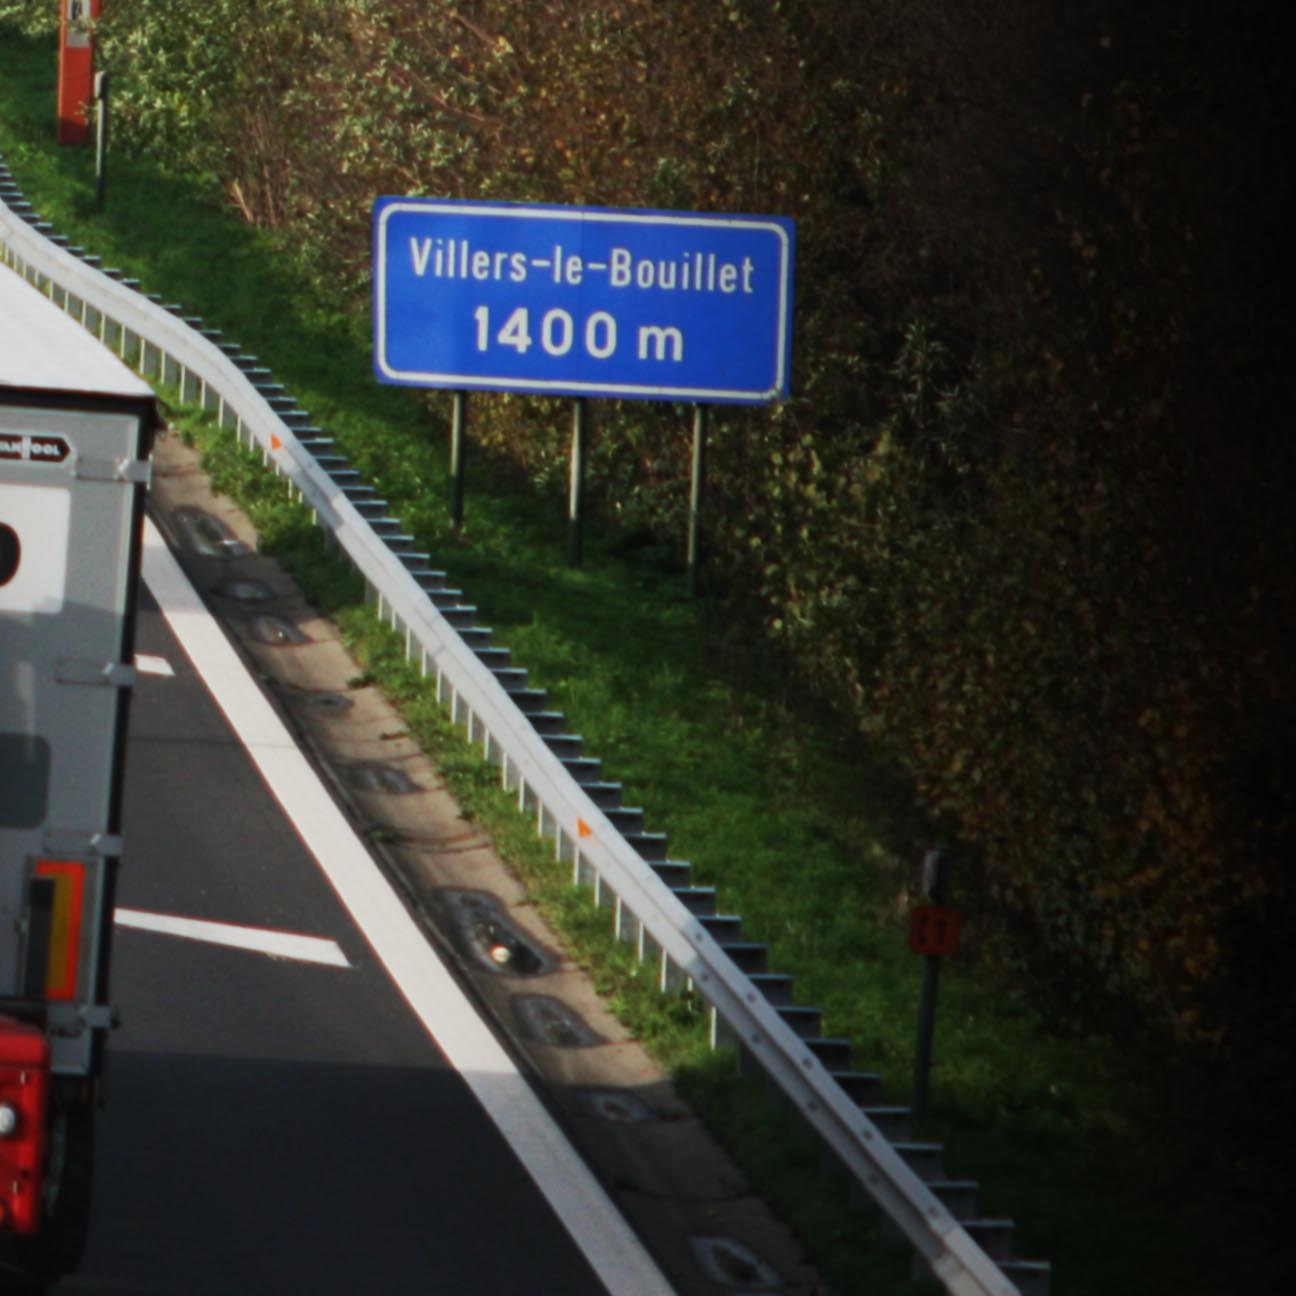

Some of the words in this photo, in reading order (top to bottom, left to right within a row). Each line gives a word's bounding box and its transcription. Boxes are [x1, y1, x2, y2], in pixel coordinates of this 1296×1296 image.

[409, 237, 754, 294] Villers-le-Bouillet
[474, 306, 618, 359] 1400
[638, 324, 683, 362] m
